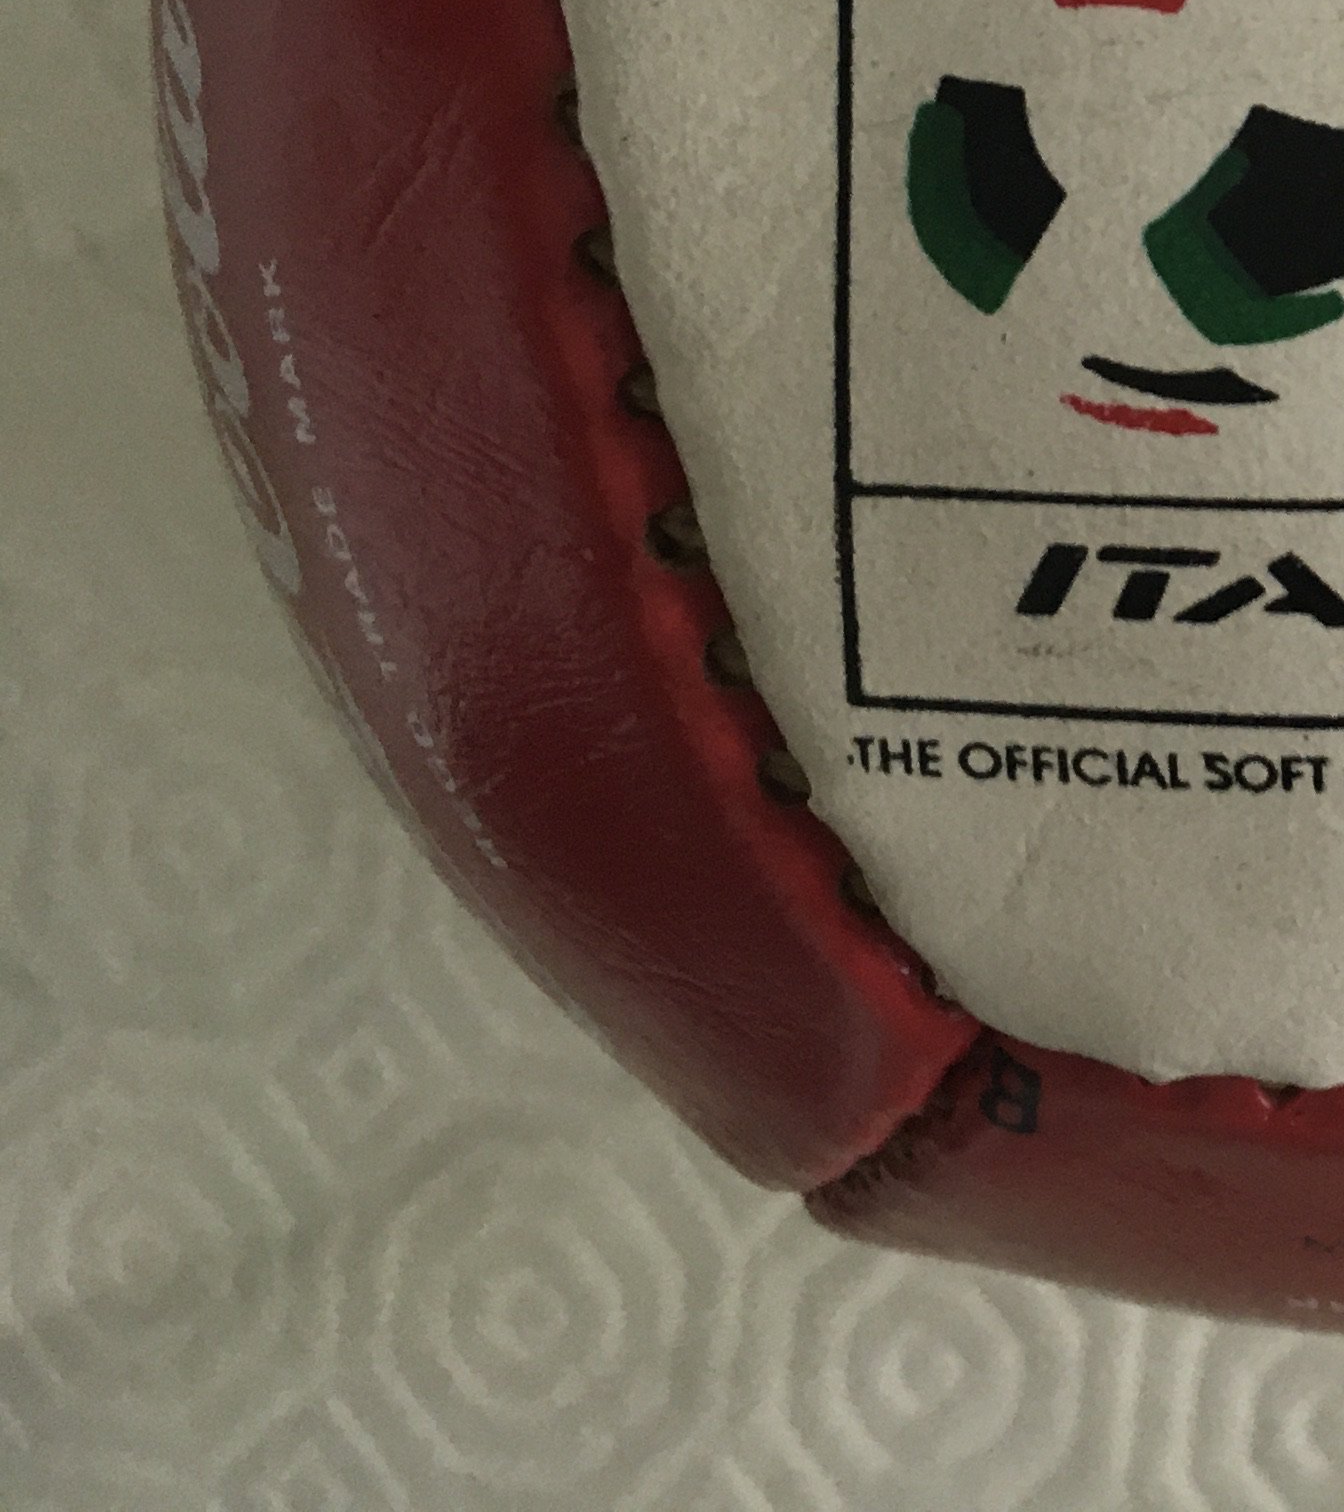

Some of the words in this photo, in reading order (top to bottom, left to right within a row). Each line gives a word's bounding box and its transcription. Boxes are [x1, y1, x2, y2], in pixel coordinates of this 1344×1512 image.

[259, 258, 316, 445] MARK
[852, 735, 942, 778] THE
[958, 741, 1189, 789] OFFICIAL
[1202, 751, 1329, 794] SOFT
